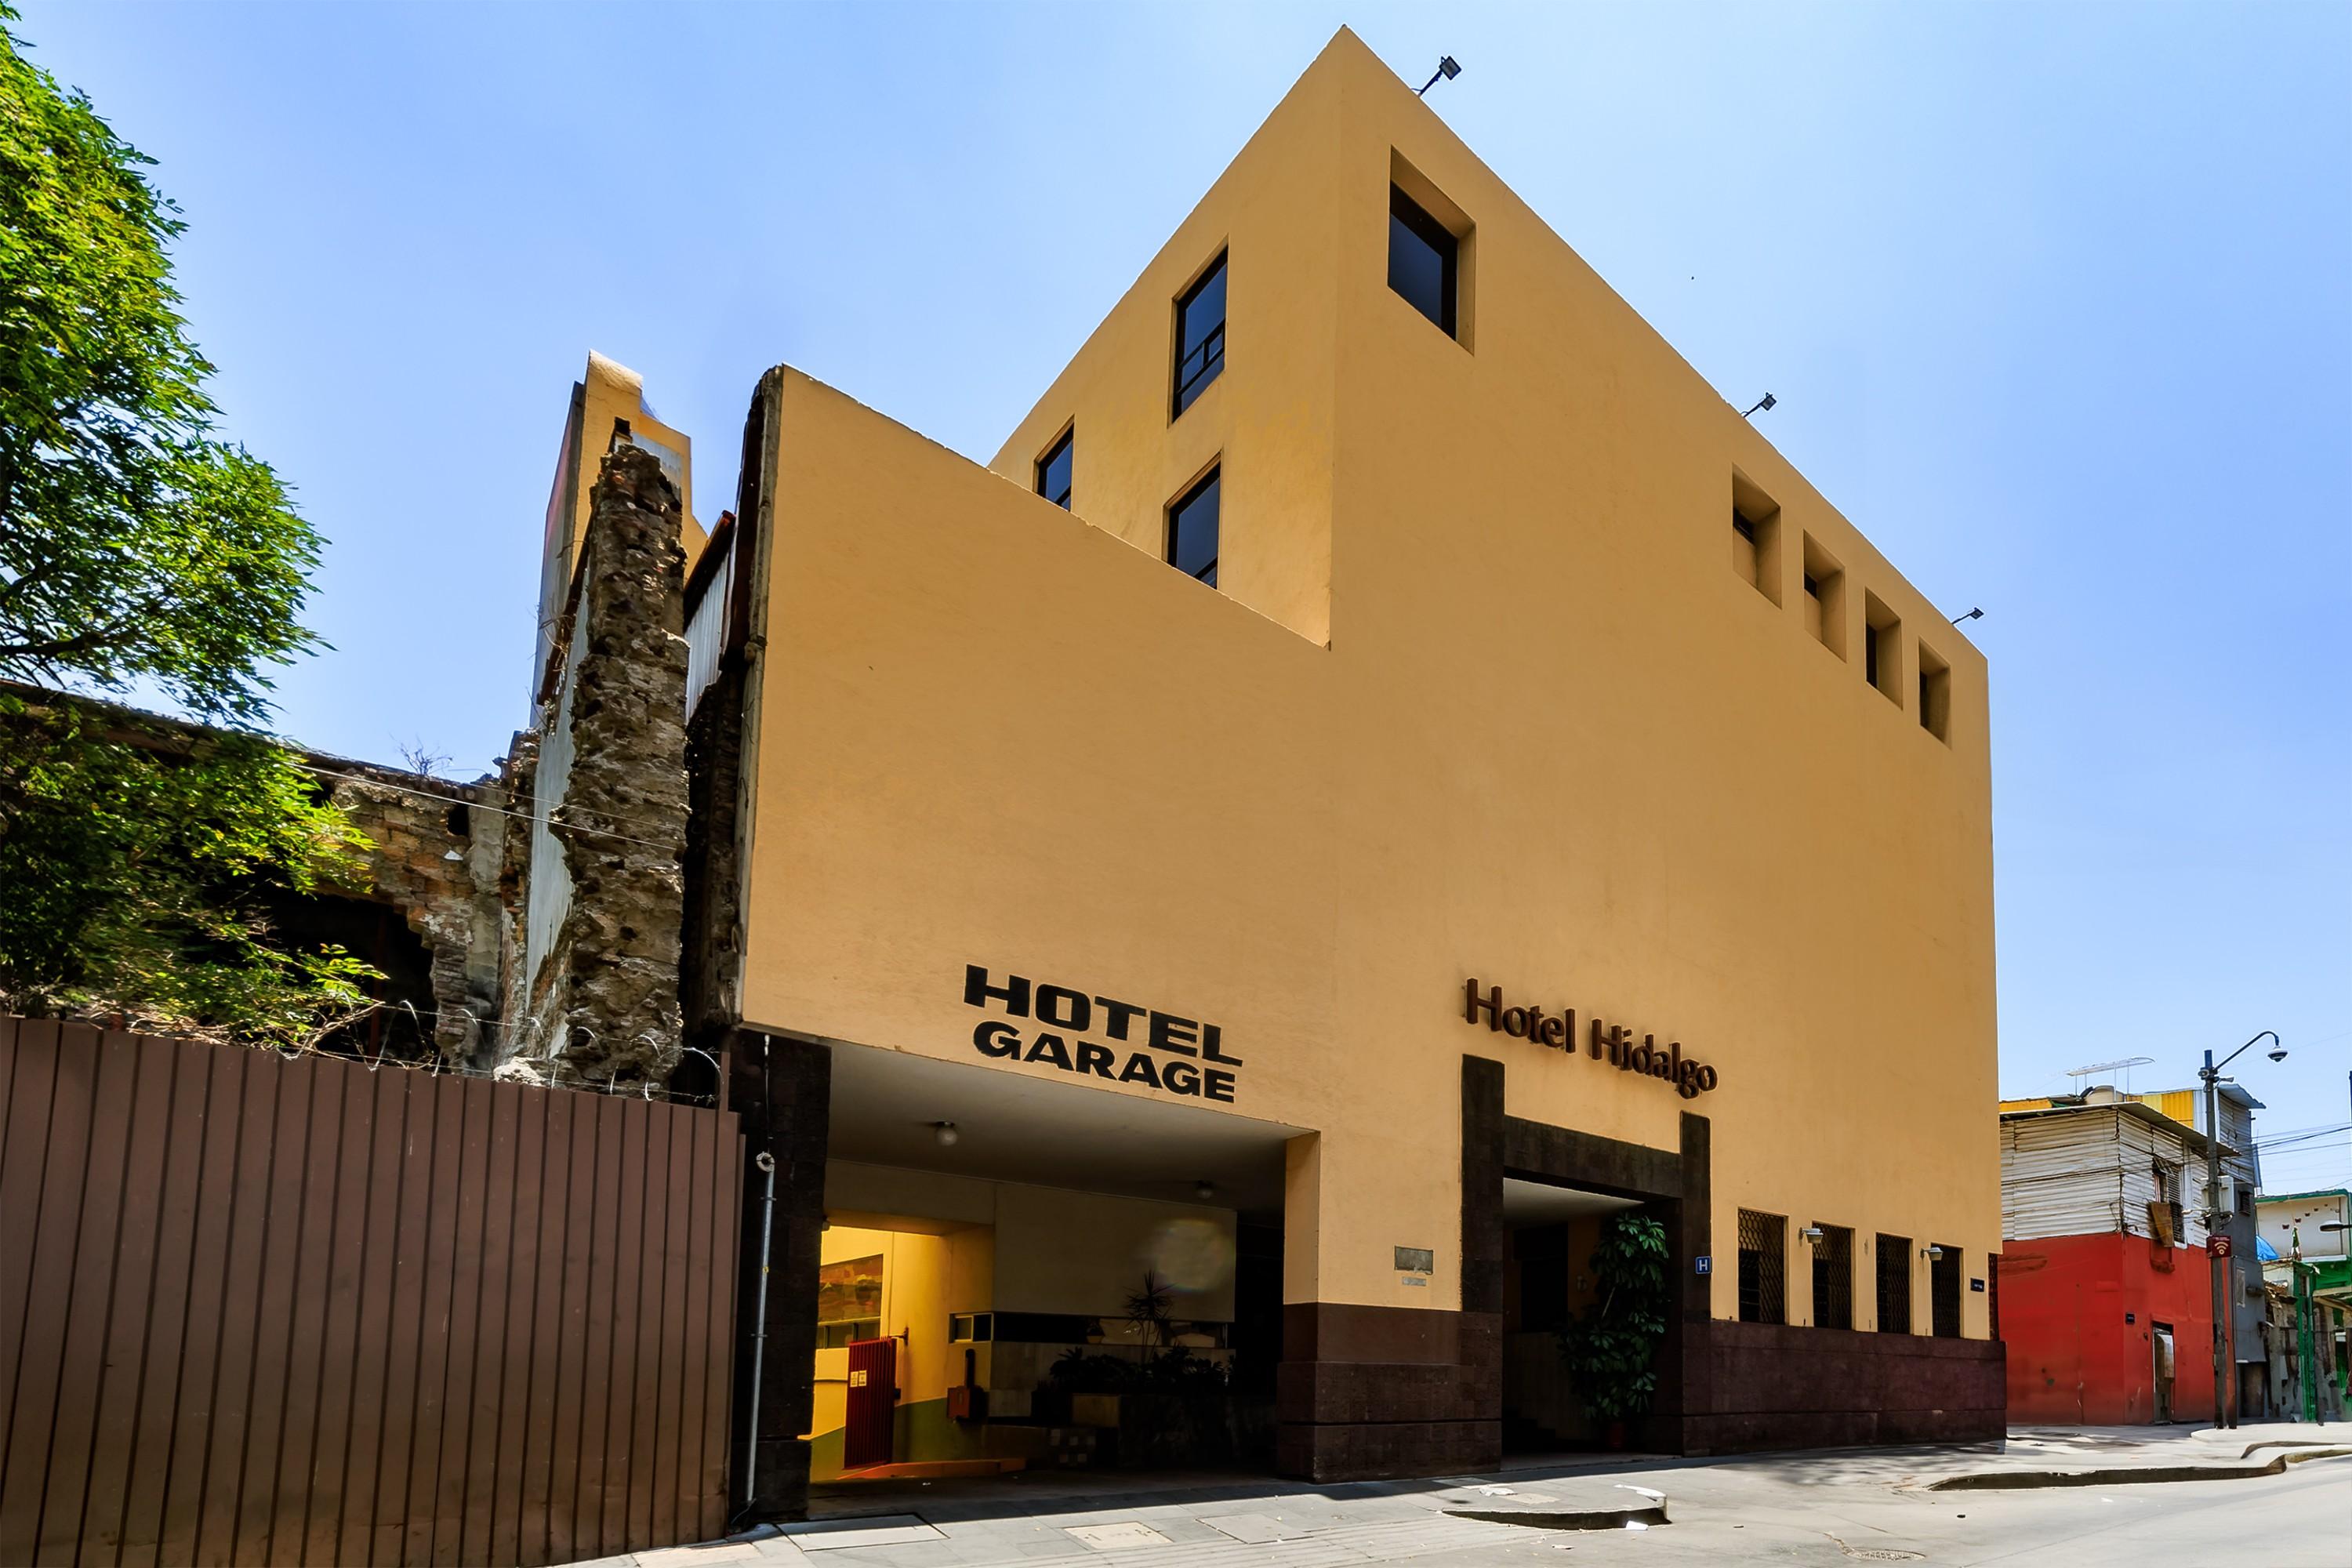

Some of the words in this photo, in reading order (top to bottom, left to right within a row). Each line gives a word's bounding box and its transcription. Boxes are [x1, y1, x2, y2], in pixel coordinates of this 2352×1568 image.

[964, 964, 1243, 1067] HOTEL
[972, 1020, 1236, 1104] GARAGE
[1466, 978, 1576, 1054] Hotel
[1591, 1018, 1719, 1099] Hidalgo
[1699, 1259, 1708, 1271] H
